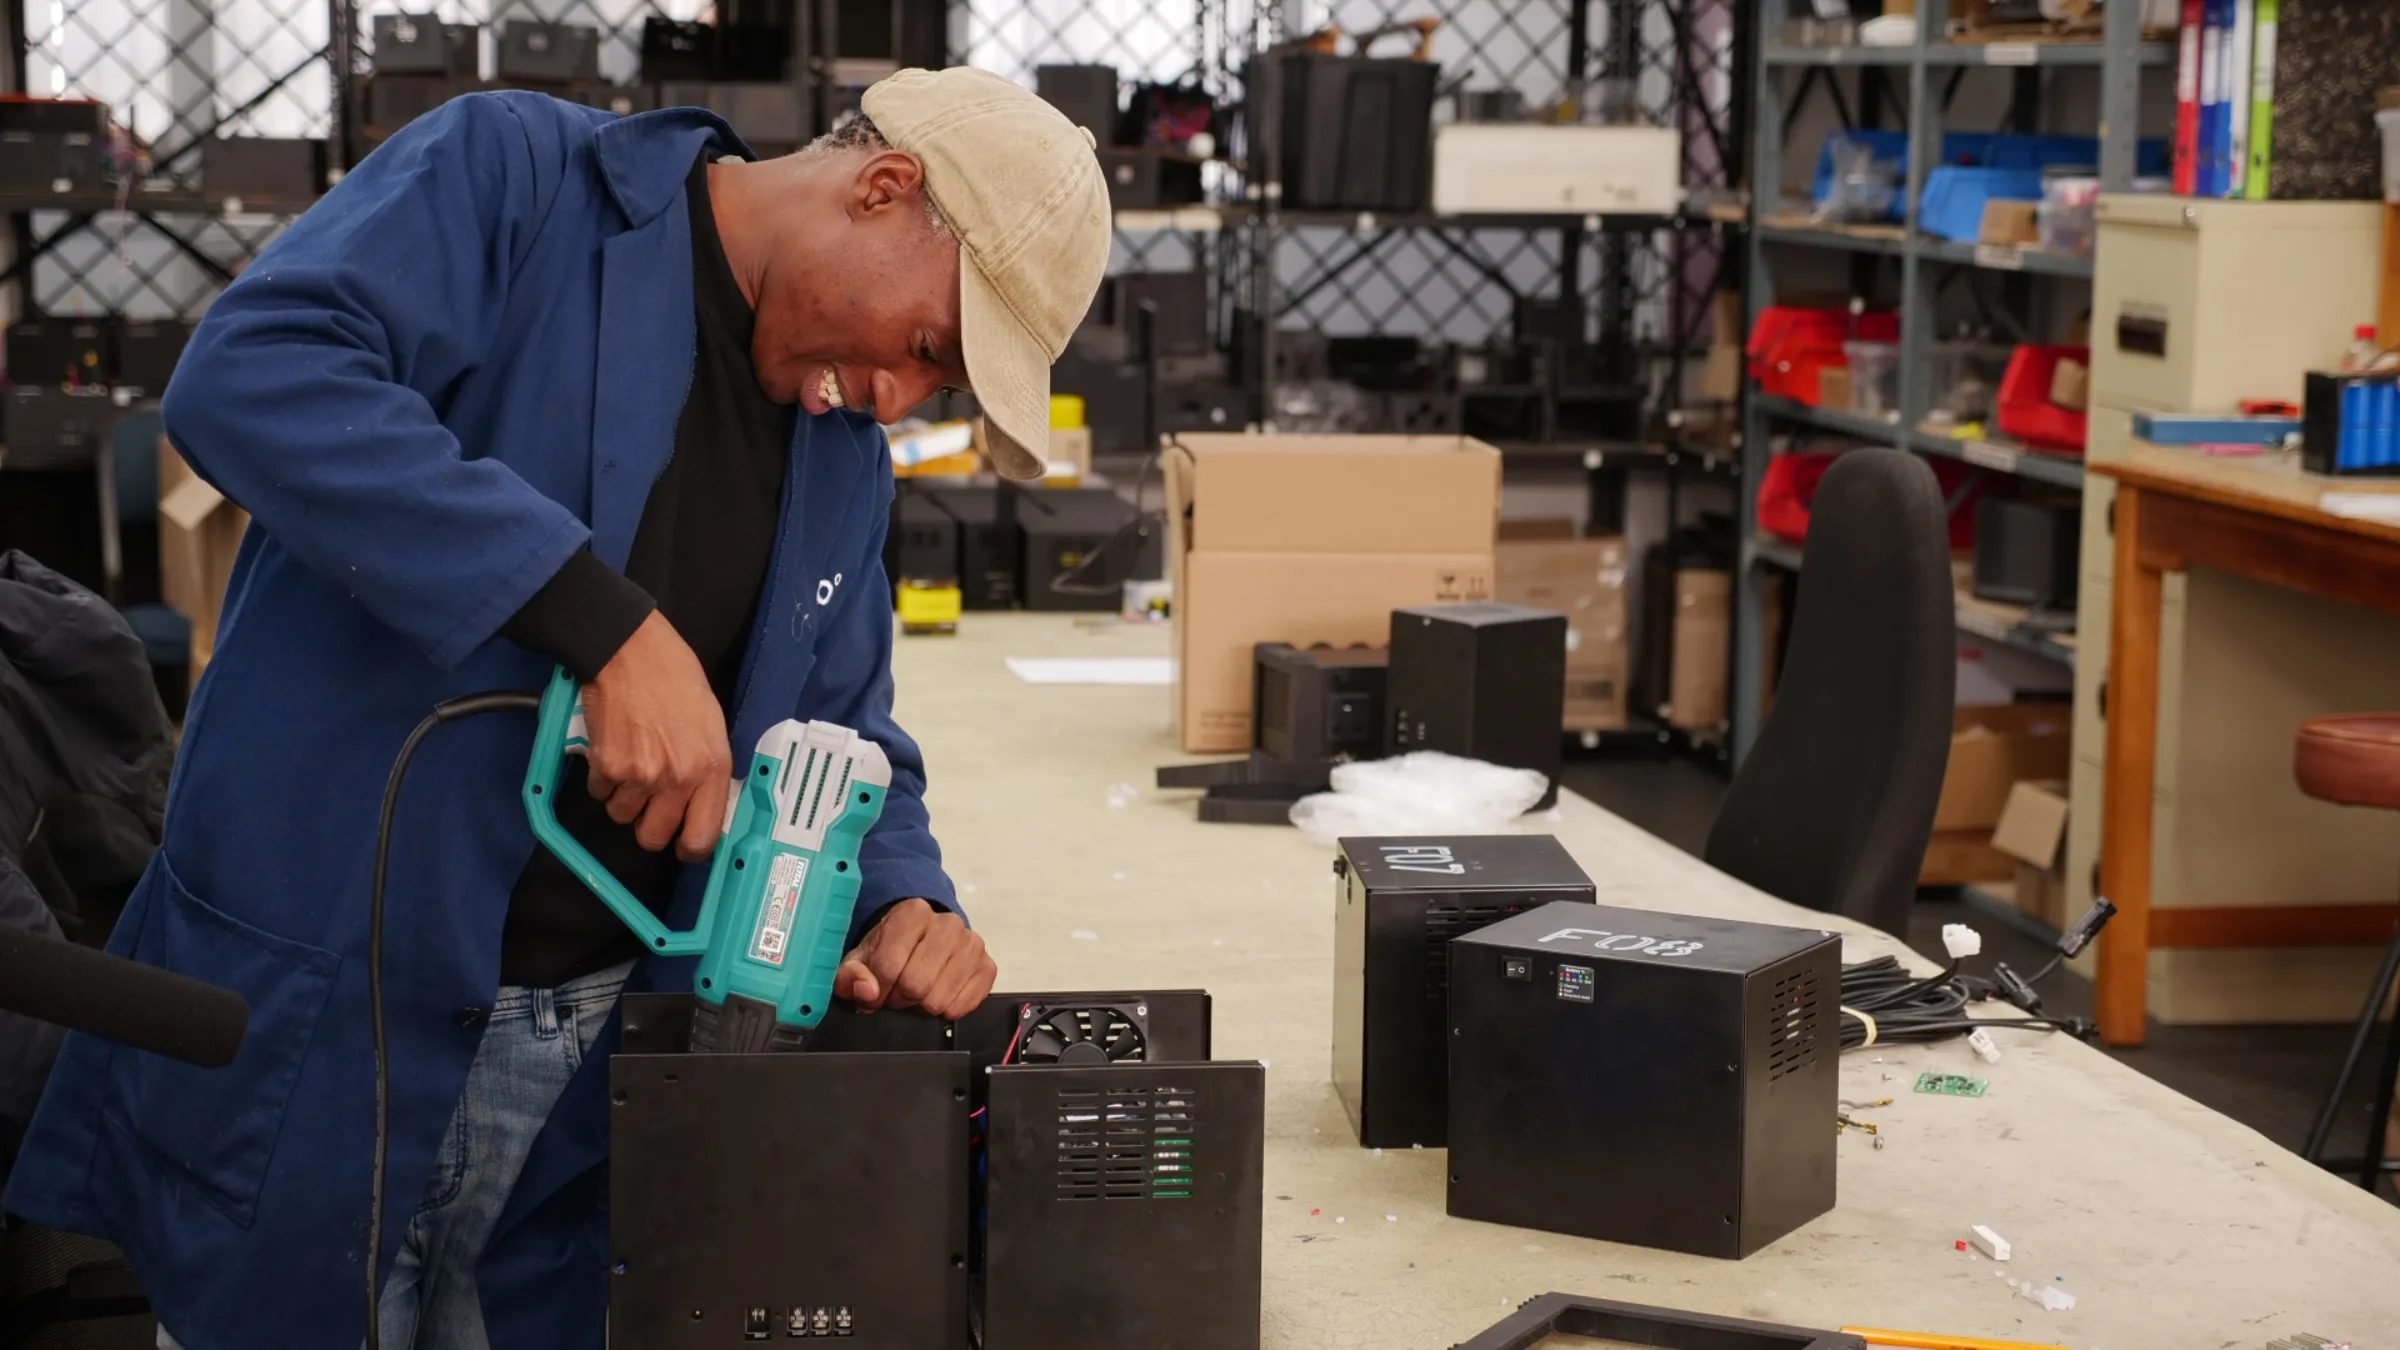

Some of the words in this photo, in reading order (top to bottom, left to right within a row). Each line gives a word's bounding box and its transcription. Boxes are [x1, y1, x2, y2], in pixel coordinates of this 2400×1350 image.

[792, 859, 805, 888] TOTAL
[1379, 846, 1465, 875] F07
[1538, 928, 1704, 957] F08
